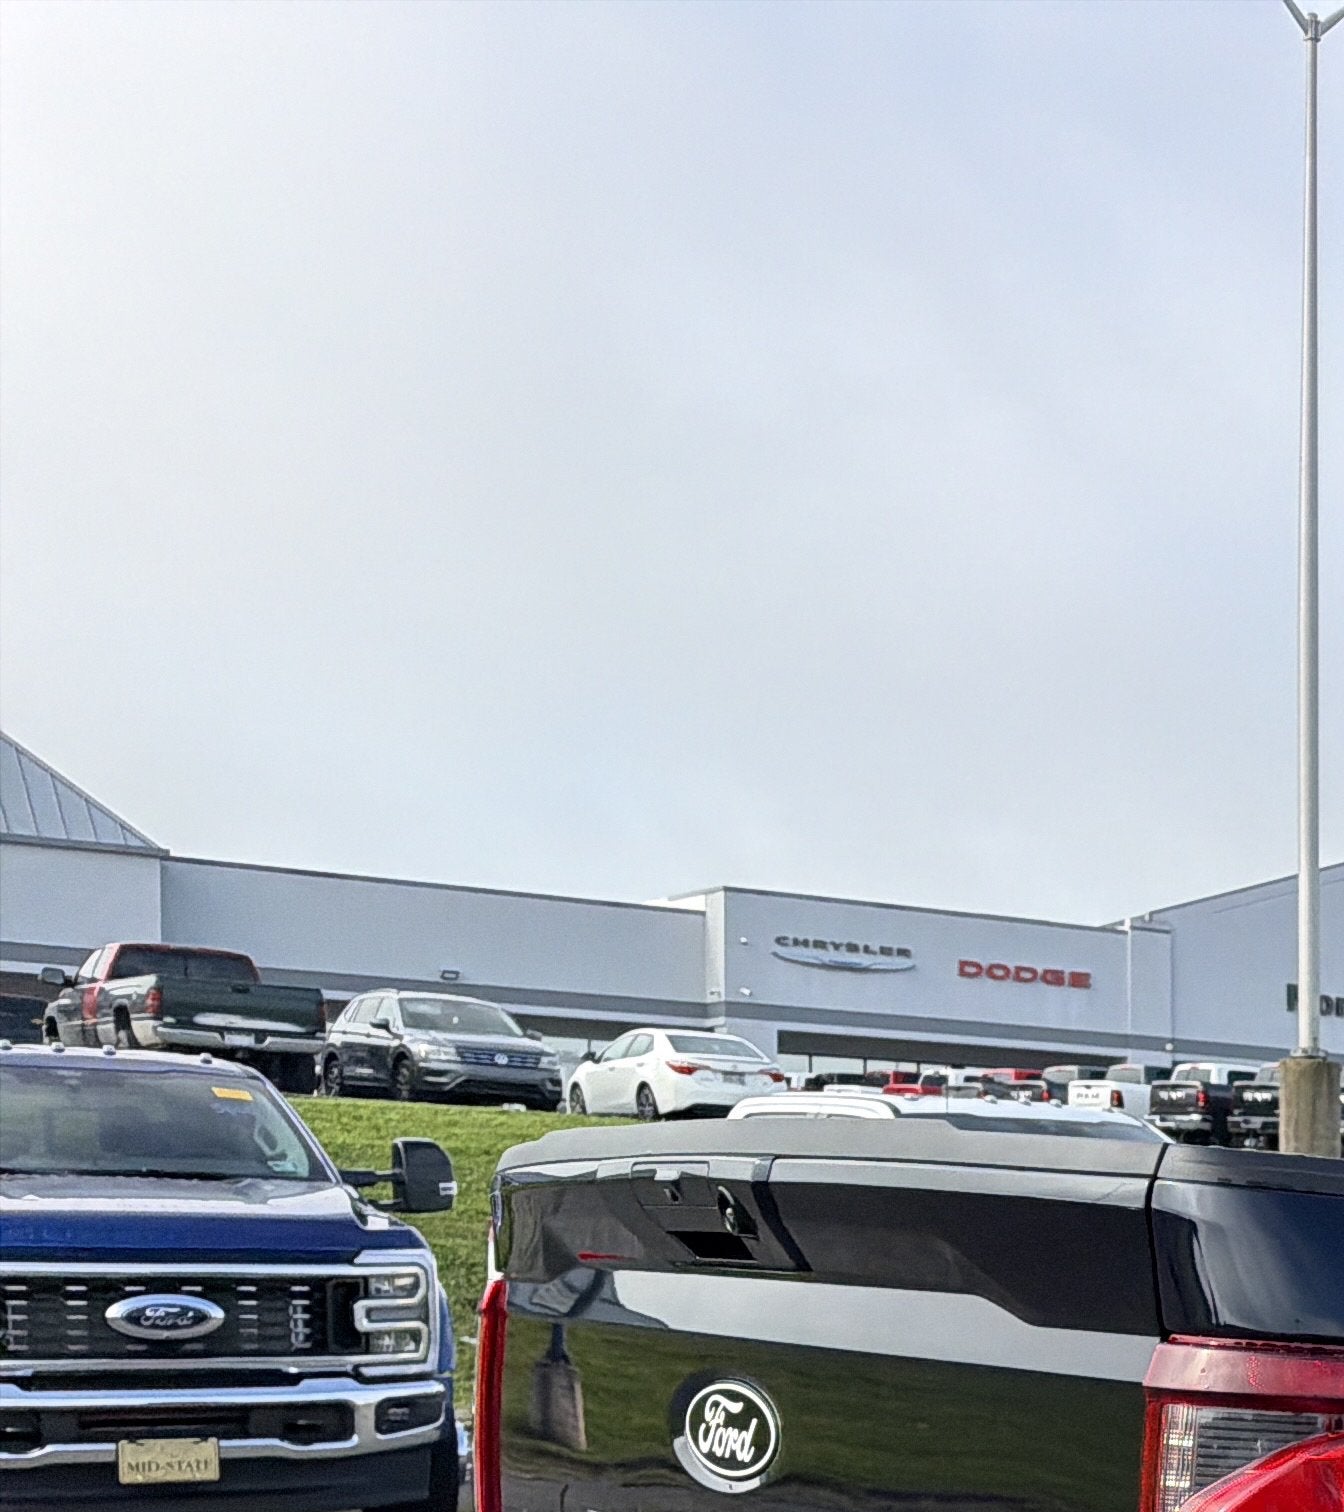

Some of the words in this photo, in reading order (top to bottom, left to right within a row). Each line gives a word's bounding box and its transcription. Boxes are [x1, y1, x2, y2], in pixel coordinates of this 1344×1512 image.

[774, 935, 912, 958] CHRYSLER
[958, 959, 1092, 989] DODGE
[140, 1306, 195, 1326] Ford
[697, 1393, 759, 1463] Ford
